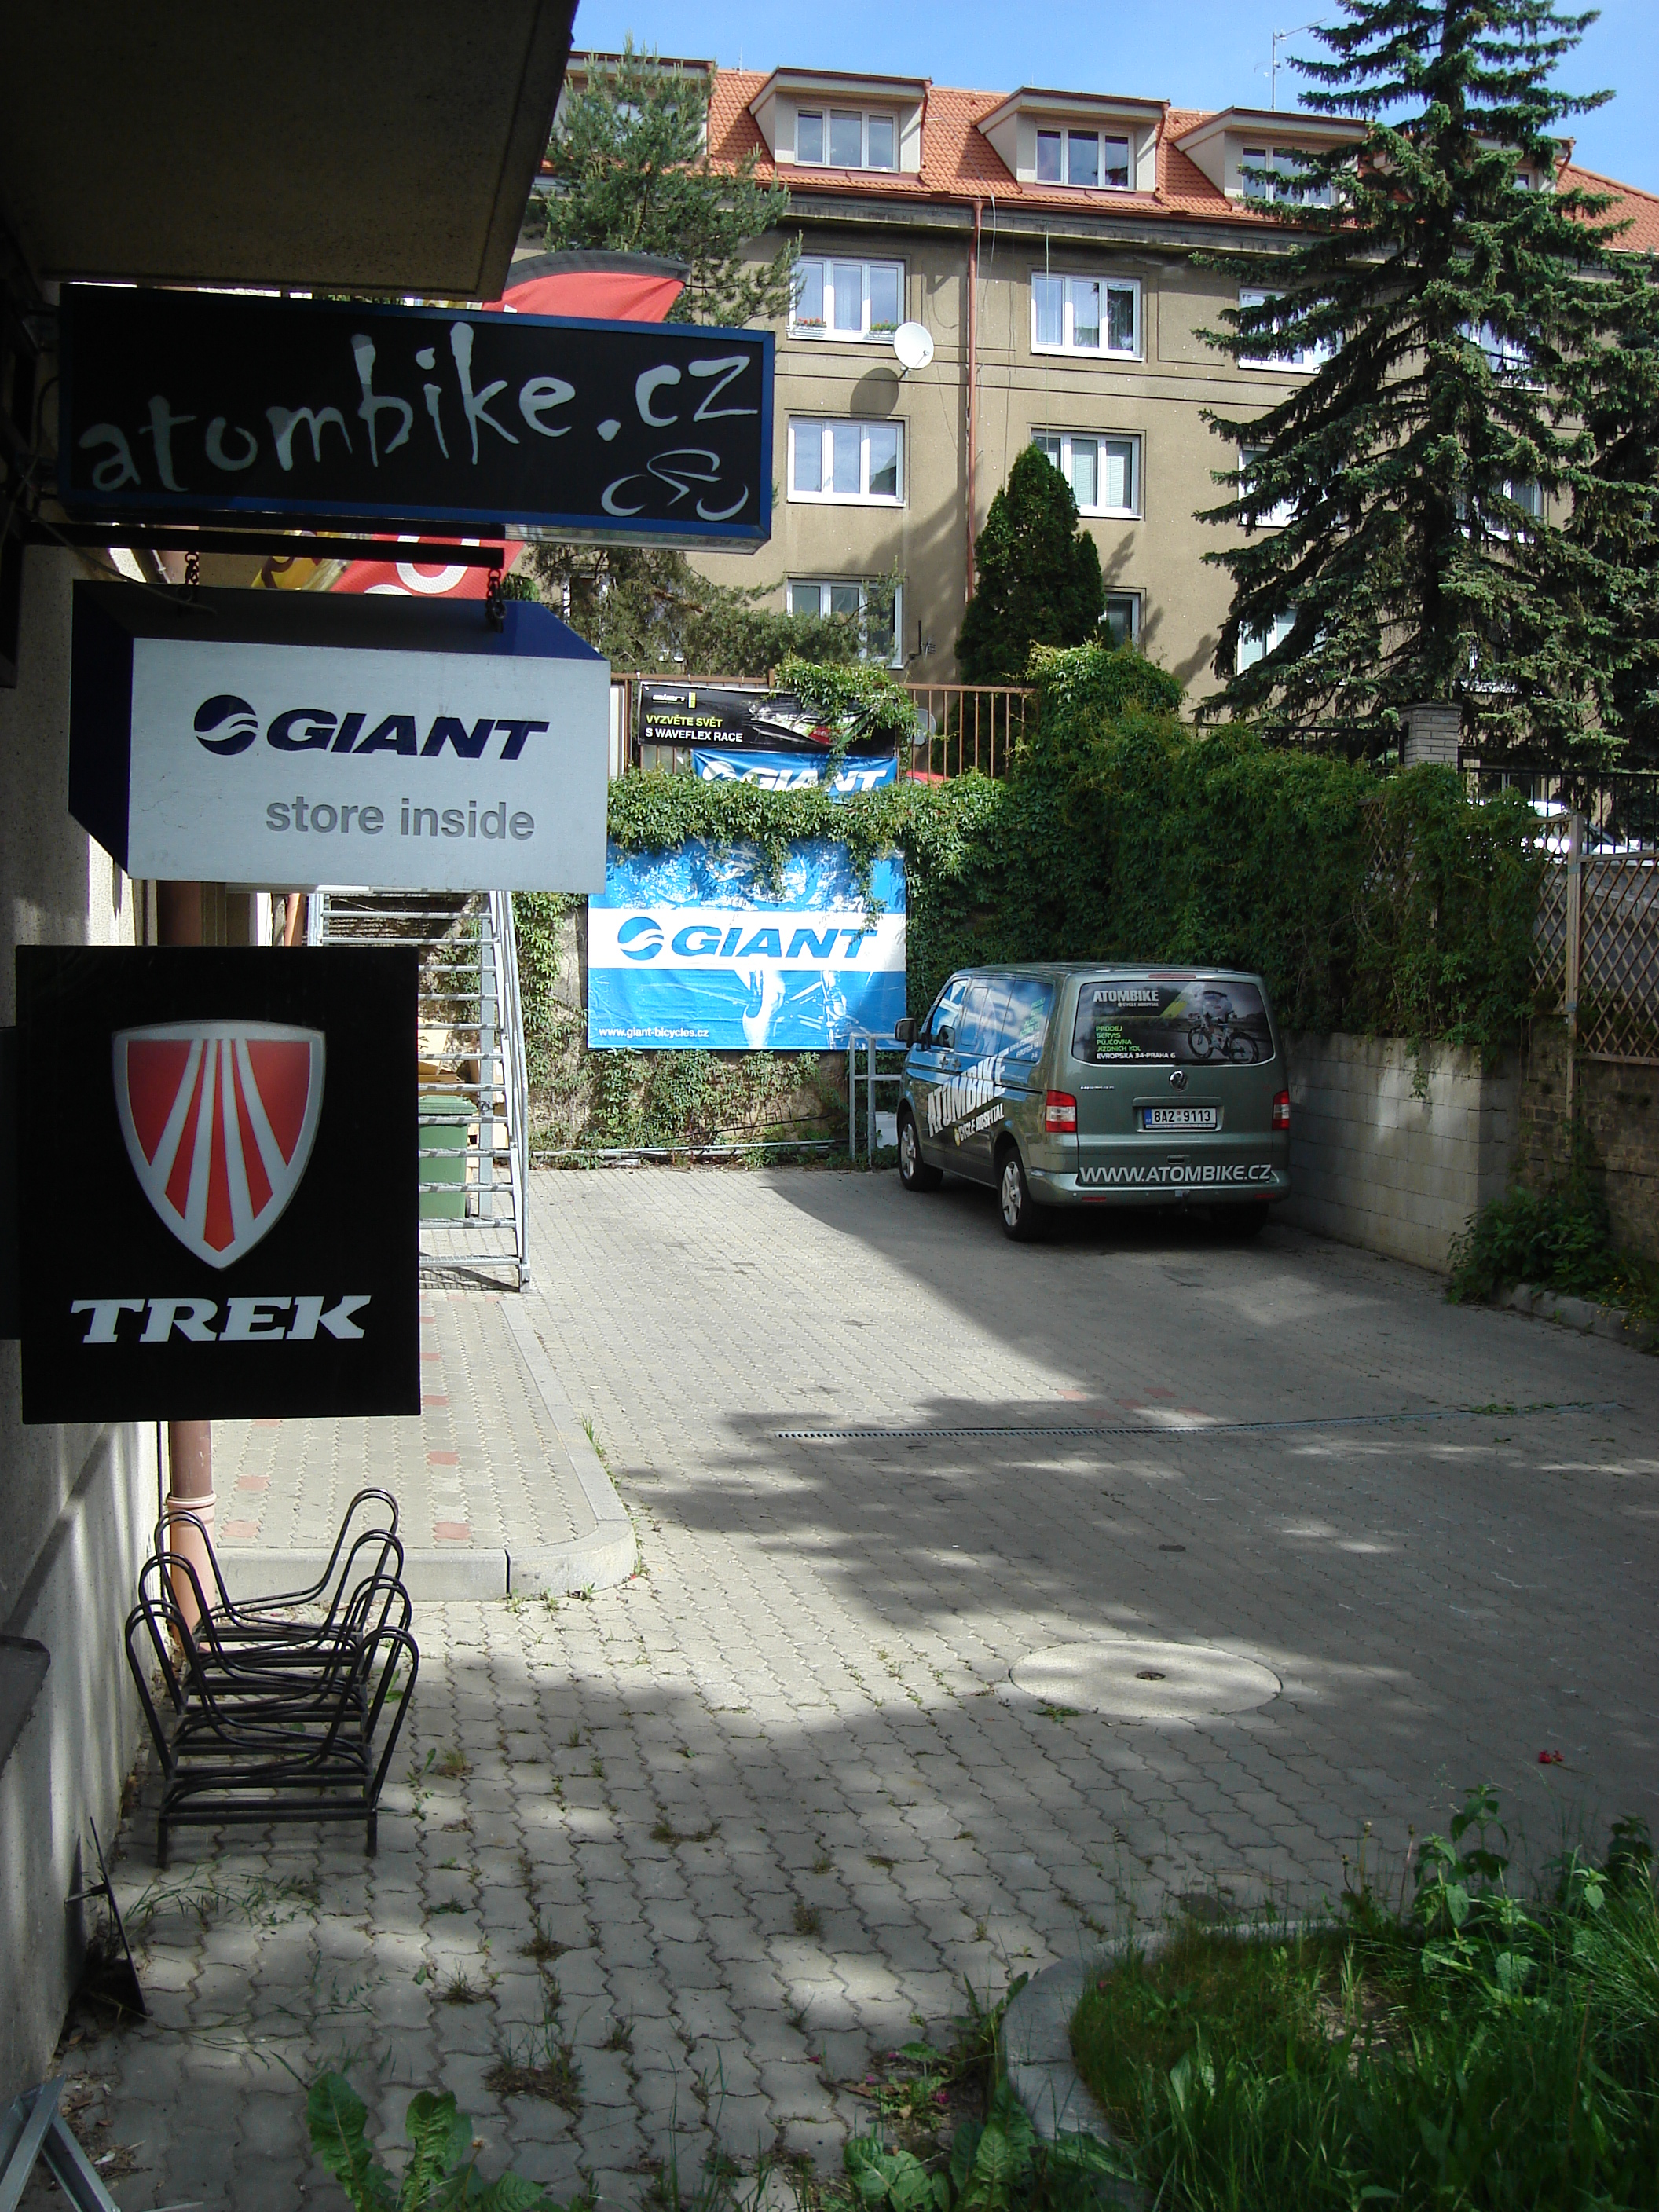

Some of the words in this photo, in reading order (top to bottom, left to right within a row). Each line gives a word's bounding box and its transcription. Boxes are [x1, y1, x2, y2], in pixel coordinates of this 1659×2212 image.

[79, 321, 758, 493] atombike.cz
[646, 714, 694, 727] VYZVĚTE
[696, 716, 723, 727] SVĚT
[266, 709, 550, 760] GIANT
[645, 727, 654, 738] S
[654, 727, 712, 739] WAVEFLEX
[713, 732, 743, 742] RACE
[266, 796, 385, 835] store
[401, 798, 535, 840] inside
[671, 925, 877, 958] GIANT
[1093, 990, 1159, 1002] ATOMBIKE
[599, 1027, 709, 1039] www.giant-bicycles.cz
[927, 1047, 1010, 1138] ATOMBIKE
[1154, 1110, 1175, 1122] 8A2
[1183, 1109, 1211, 1122] 9113
[1079, 1164, 1272, 1182] WWW.ATOMBIKE.CZ
[71, 1295, 372, 1344] TREK
